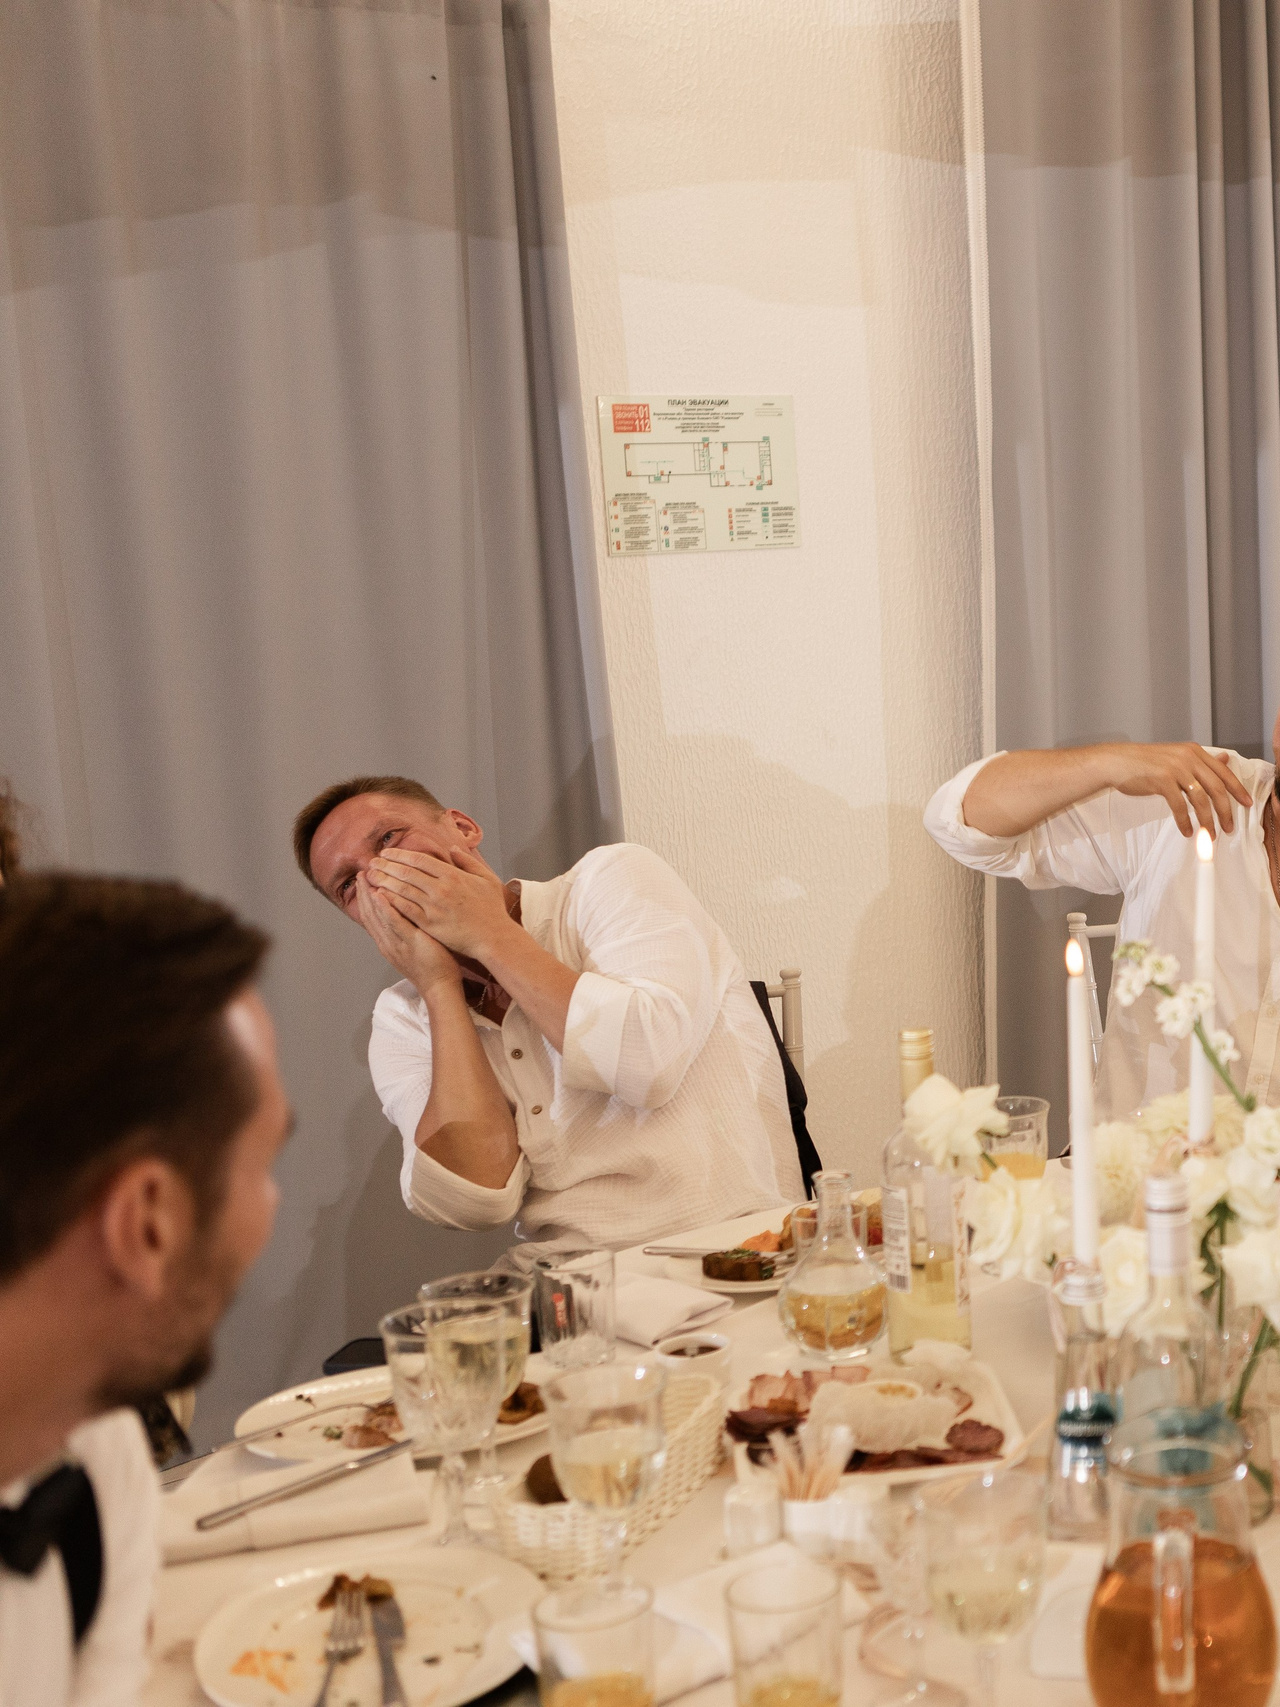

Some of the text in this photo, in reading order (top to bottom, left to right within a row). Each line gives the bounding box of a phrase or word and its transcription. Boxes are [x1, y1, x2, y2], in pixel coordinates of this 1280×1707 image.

[667, 399, 729, 408] ПЛАН ЭВАКУАЦИИ
[638, 405, 649, 419] 01
[634, 419, 651, 432] 112
